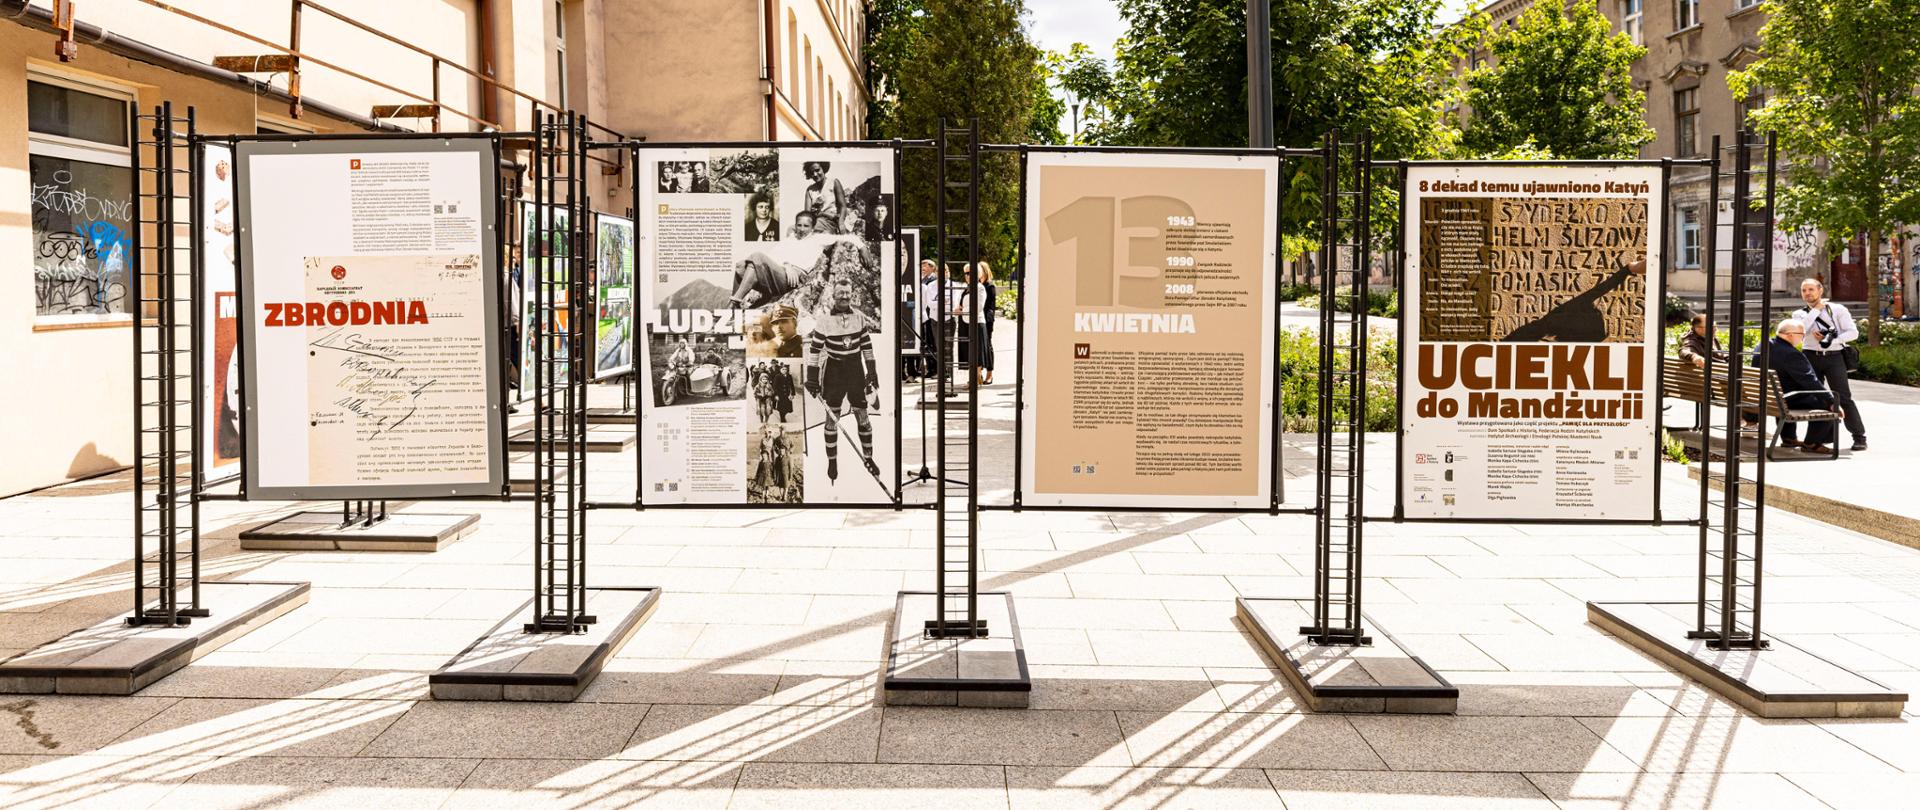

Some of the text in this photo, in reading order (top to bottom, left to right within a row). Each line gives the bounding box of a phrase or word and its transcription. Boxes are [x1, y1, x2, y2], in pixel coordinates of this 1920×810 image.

[1419, 180, 1649, 196] 8 dekad temu ujawniono Katyń
[1167, 216, 1194, 226] 1943
[1500, 202, 1608, 224] SZYDEŁKO
[1044, 195, 1196, 309] 13
[1166, 256, 1194, 266] 1990
[1165, 284, 1194, 294] 2008
[264, 301, 429, 328] ZBRODNIA
[1074, 313, 1196, 333] KWIETNIA
[1418, 344, 1644, 390] UCIEKLI
[1417, 391, 1643, 419] do Mandżurii
